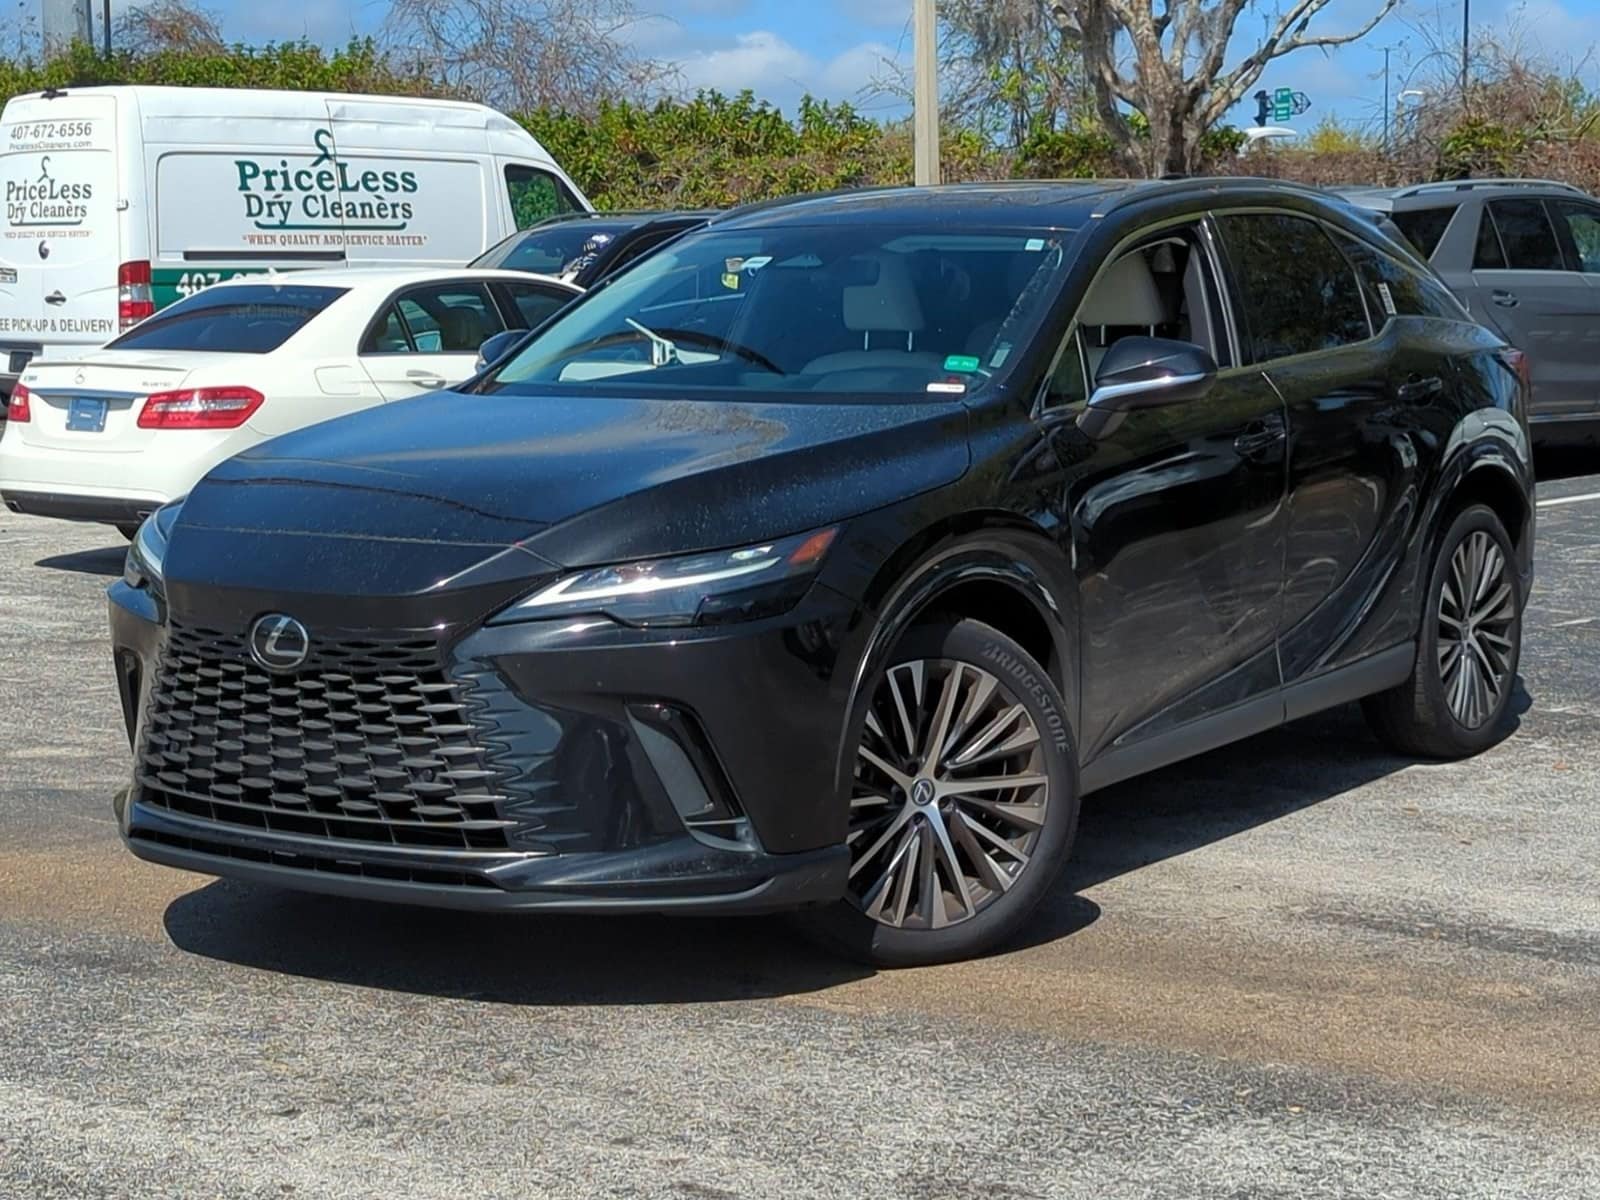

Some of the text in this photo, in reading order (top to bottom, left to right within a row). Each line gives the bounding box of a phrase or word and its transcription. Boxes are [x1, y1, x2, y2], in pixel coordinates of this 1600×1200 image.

[10, 122, 92, 139] 407-672-6556
[235, 160, 418, 192] PriceLess
[6, 178, 92, 201] PriceLess
[30, 201, 87, 218] Cleaners
[243, 193, 413, 224] Dry Cleaners
[280, 234, 320, 246] QUALITY
[323, 234, 343, 246] AND
[346, 235, 384, 246] SERVICE
[12, 318, 48, 332] PICK-UP
[60, 319, 114, 332] DELIVERY
[981, 641, 1071, 753] BRIDGESTONE
